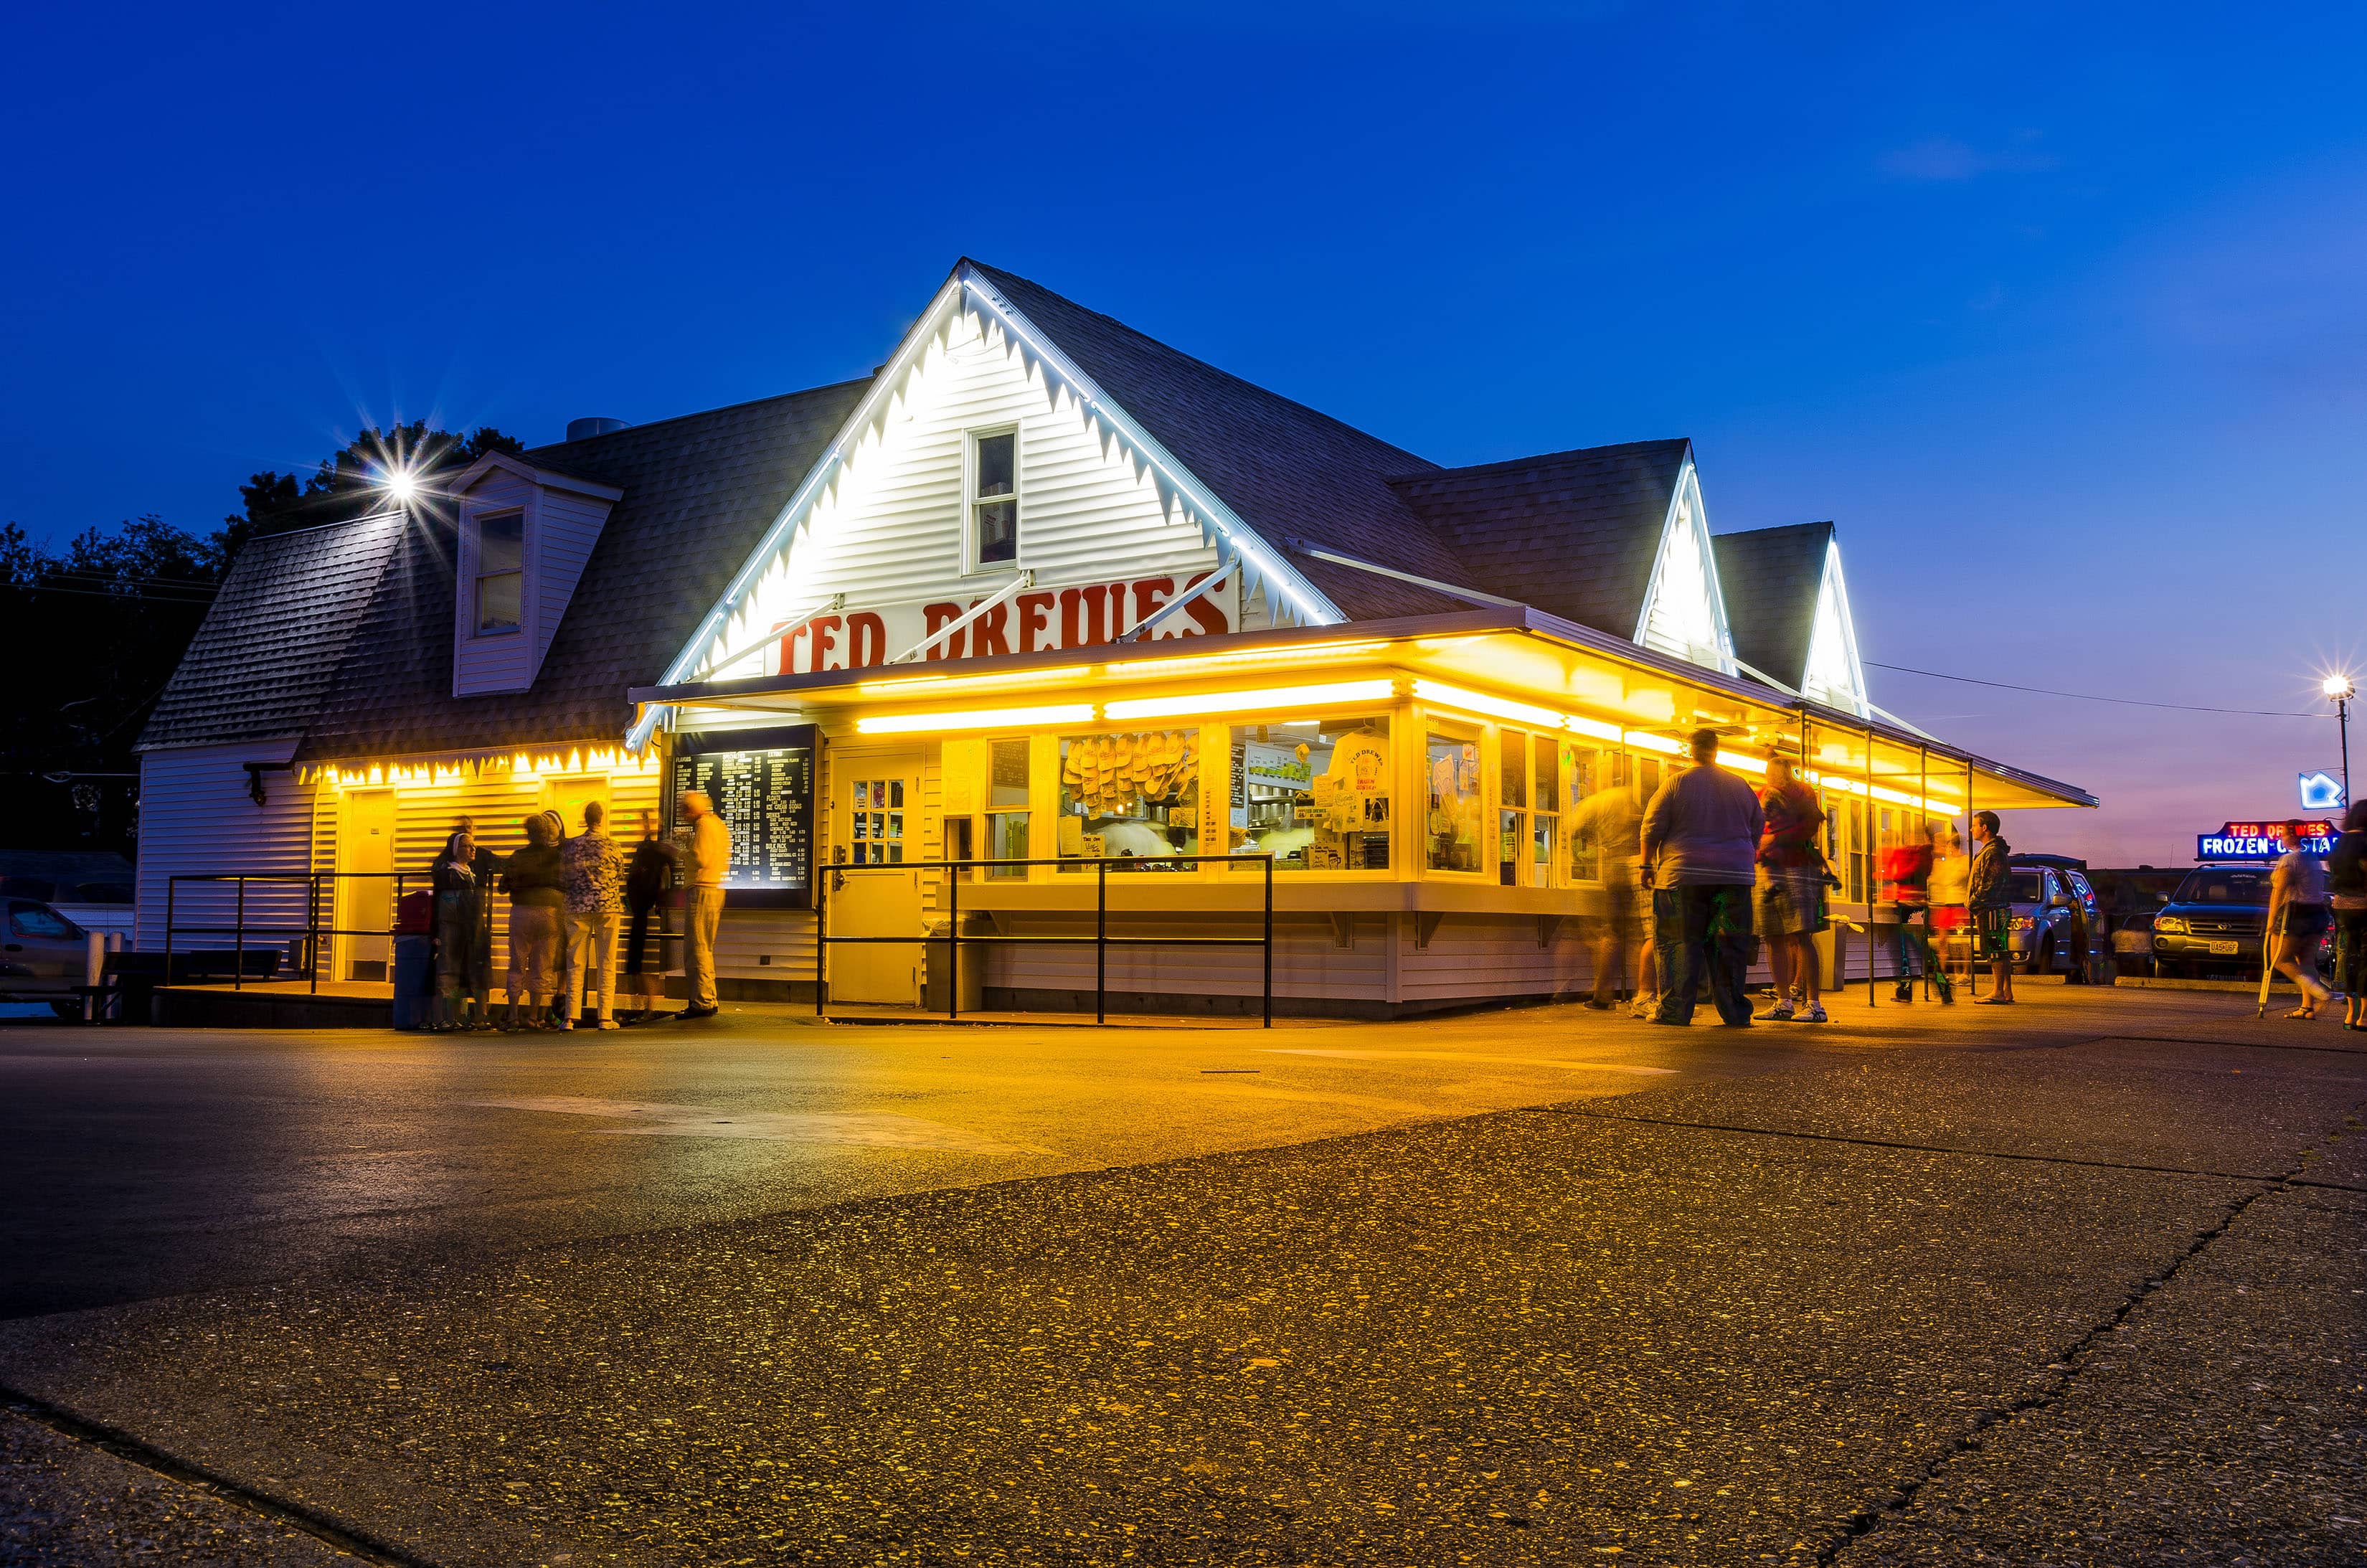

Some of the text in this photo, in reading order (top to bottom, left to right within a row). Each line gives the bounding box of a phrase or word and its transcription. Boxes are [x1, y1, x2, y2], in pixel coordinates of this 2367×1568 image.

[770, 572, 1228, 676] TED DREWES
[2230, 823, 2326, 838] TED DRWES
[2203, 838, 2269, 854] FROZEN
